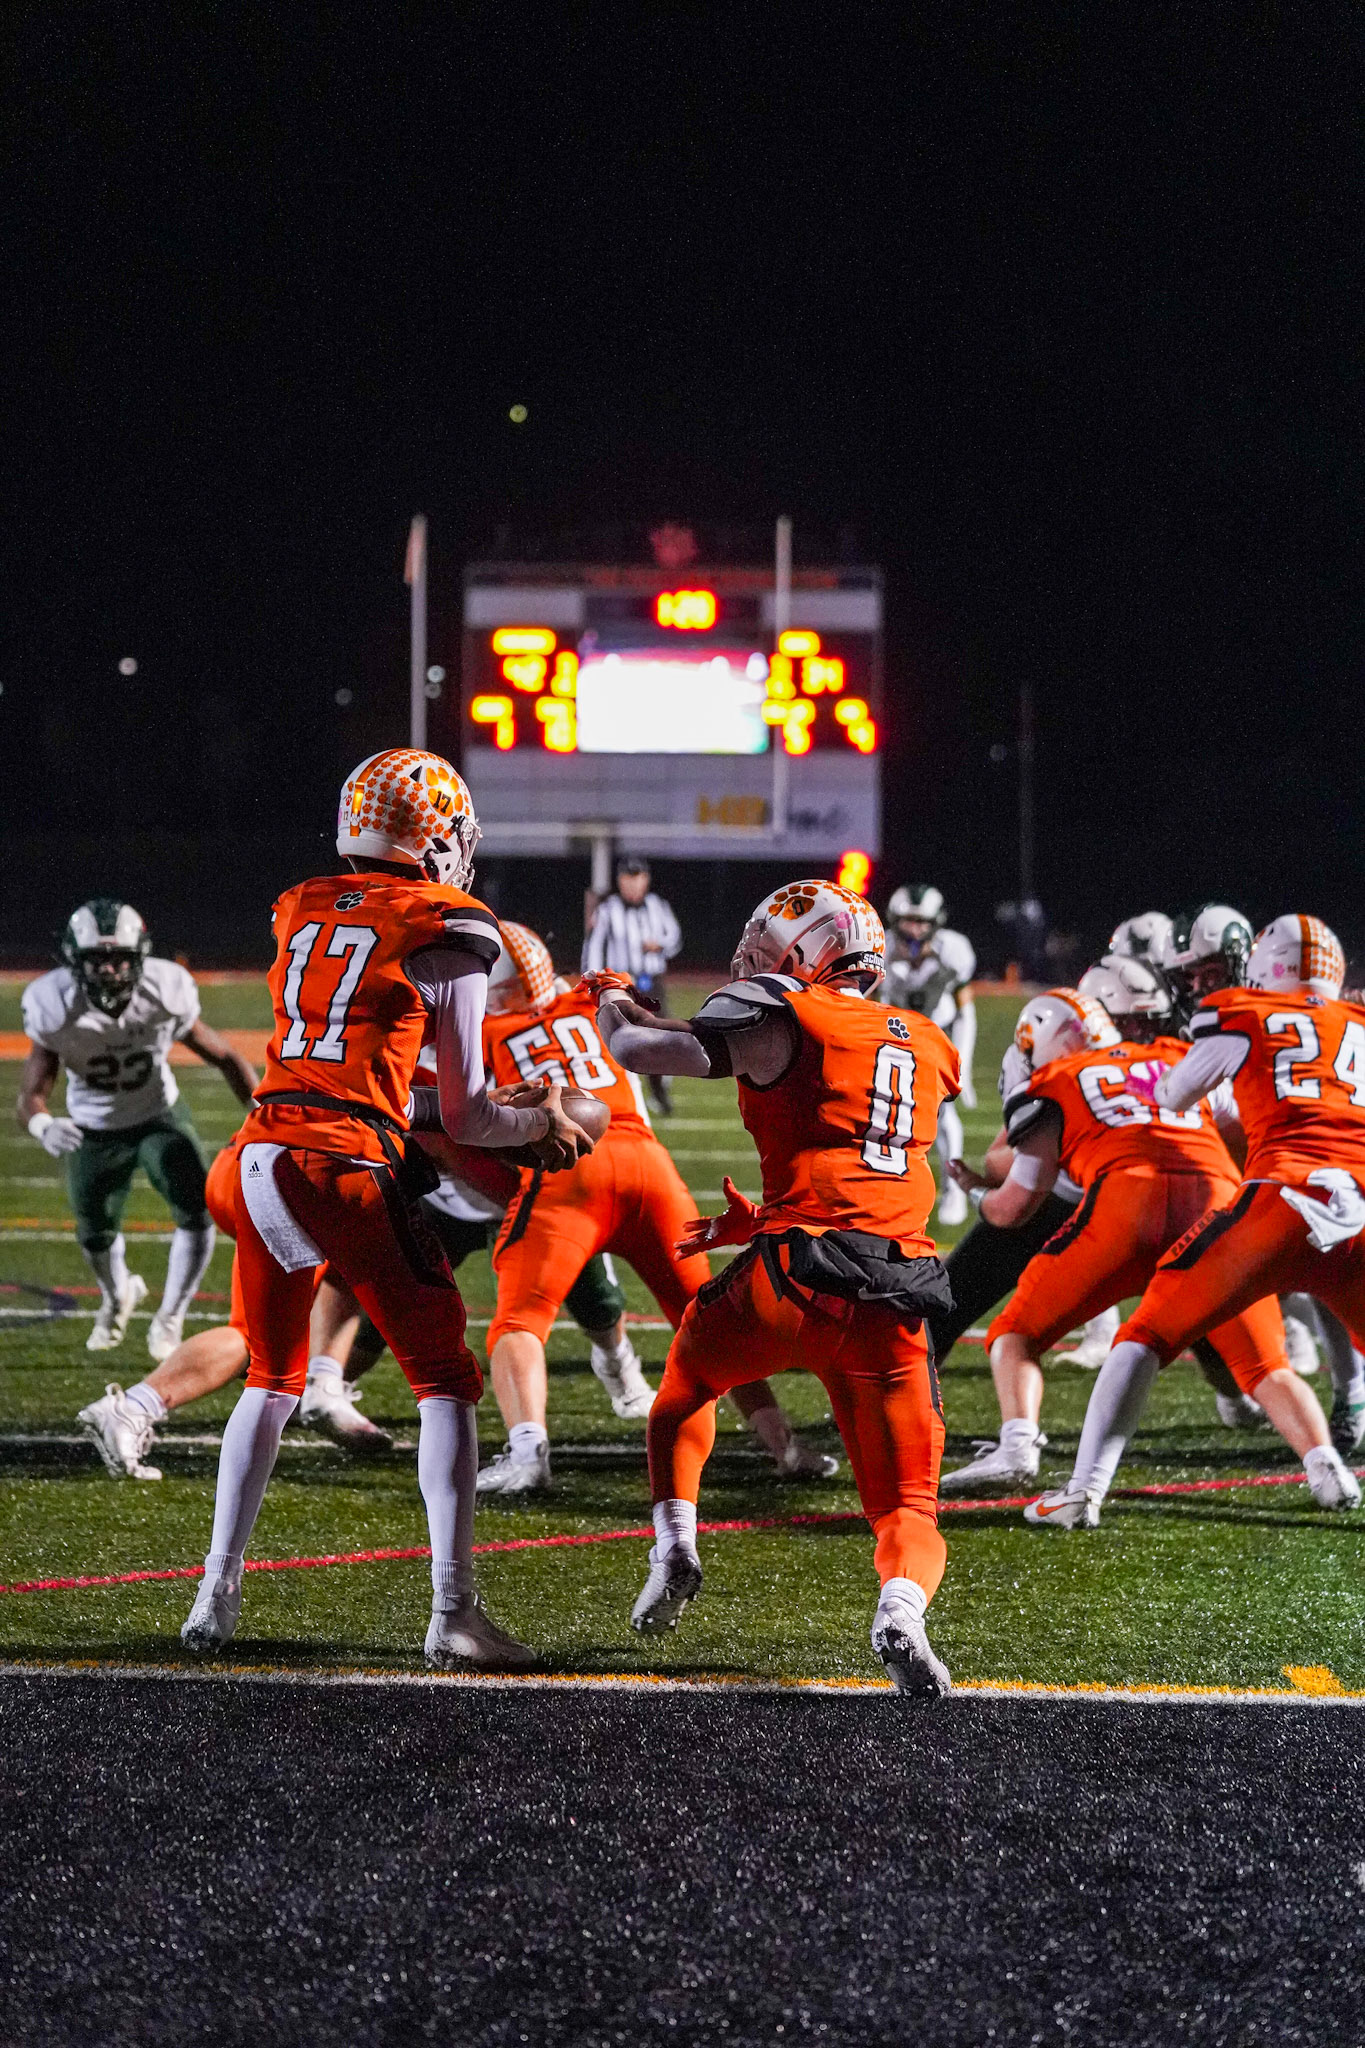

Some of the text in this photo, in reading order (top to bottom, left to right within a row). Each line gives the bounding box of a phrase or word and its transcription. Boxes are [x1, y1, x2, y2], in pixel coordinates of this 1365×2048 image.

[432, 790, 451, 814] 17
[792, 899, 805, 916] 0
[280, 920, 381, 1064] 17
[504, 1014, 618, 1090] 58
[1264, 1012, 1365, 1109] 24
[861, 1042, 917, 1176] 0
